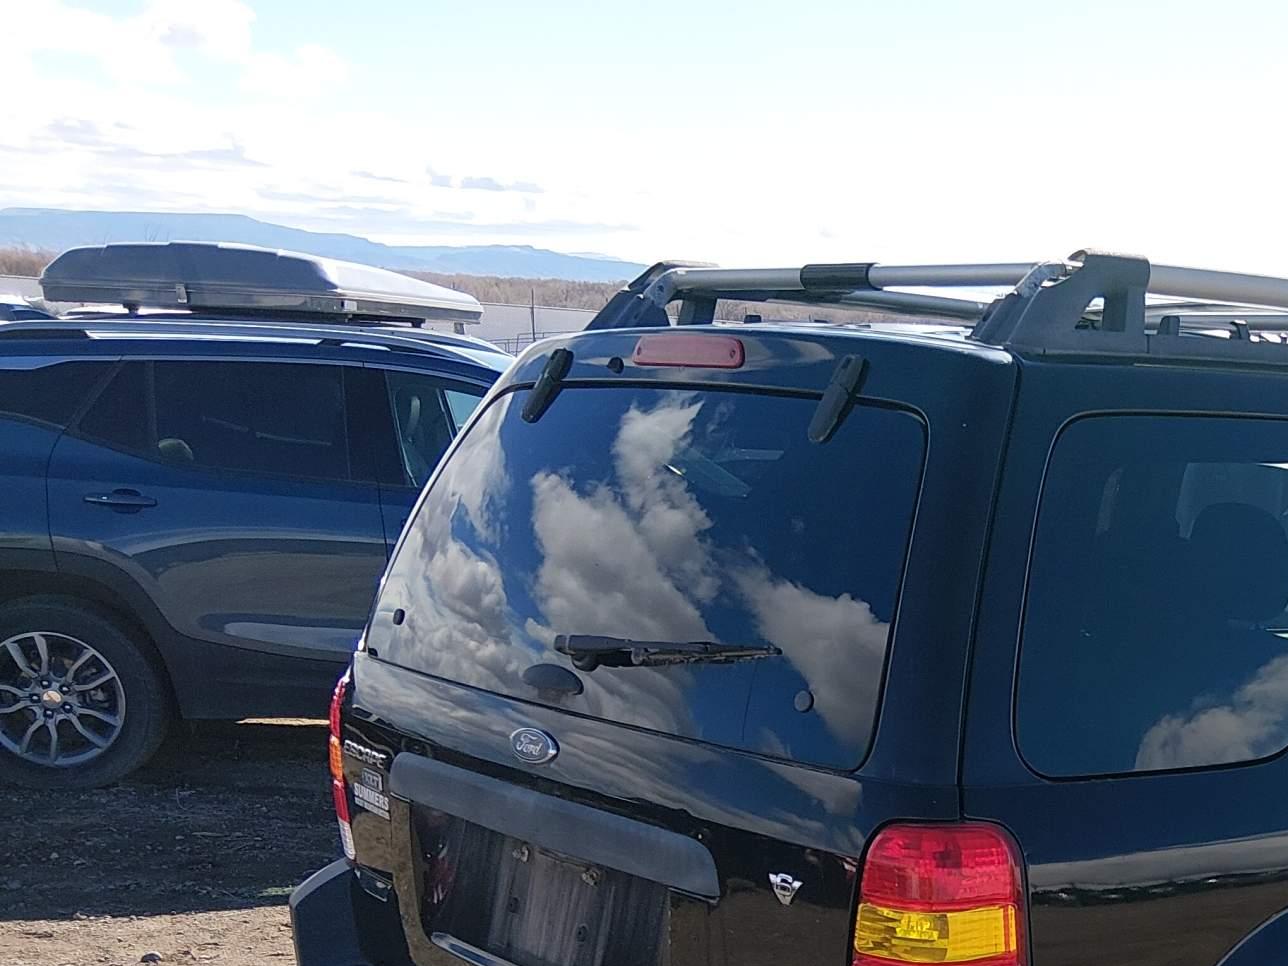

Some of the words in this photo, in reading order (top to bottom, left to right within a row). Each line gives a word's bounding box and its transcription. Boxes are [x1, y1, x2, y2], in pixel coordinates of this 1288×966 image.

[344, 739, 387, 769] ESCAPE
[516, 733, 543, 756] Ford
[354, 782, 389, 811] SUMMERS
